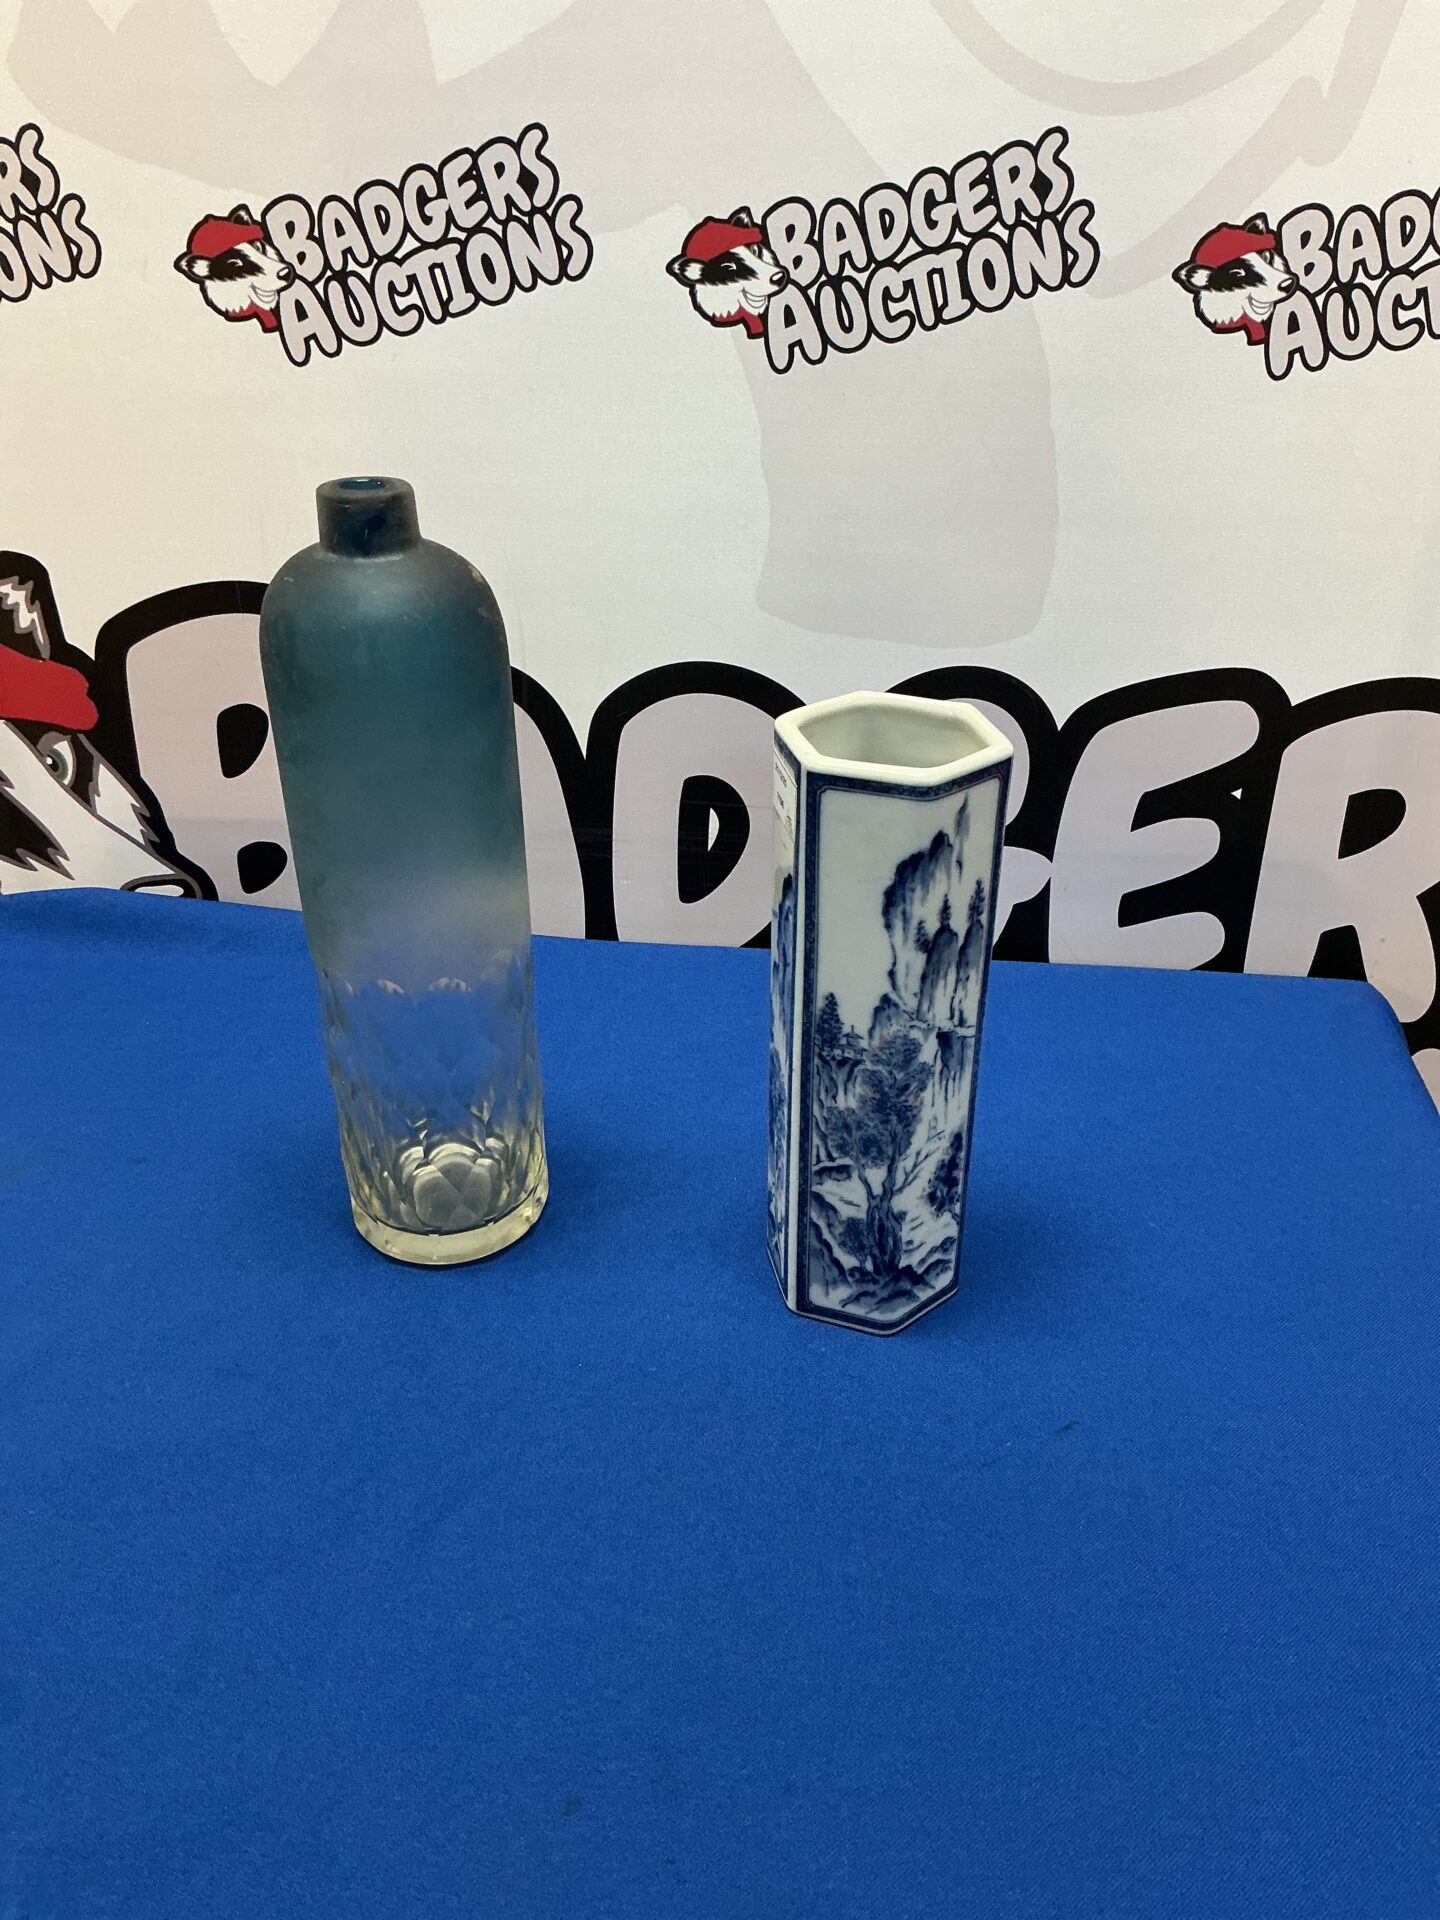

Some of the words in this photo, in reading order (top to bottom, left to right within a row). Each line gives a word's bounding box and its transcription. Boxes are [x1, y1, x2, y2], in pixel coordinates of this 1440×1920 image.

[263, 123, 559, 285] BADGERS
[278, 194, 593, 367] AUCTIONS
[761, 126, 1074, 288] BADGERS
[765, 199, 1099, 374] AUCTIONS
